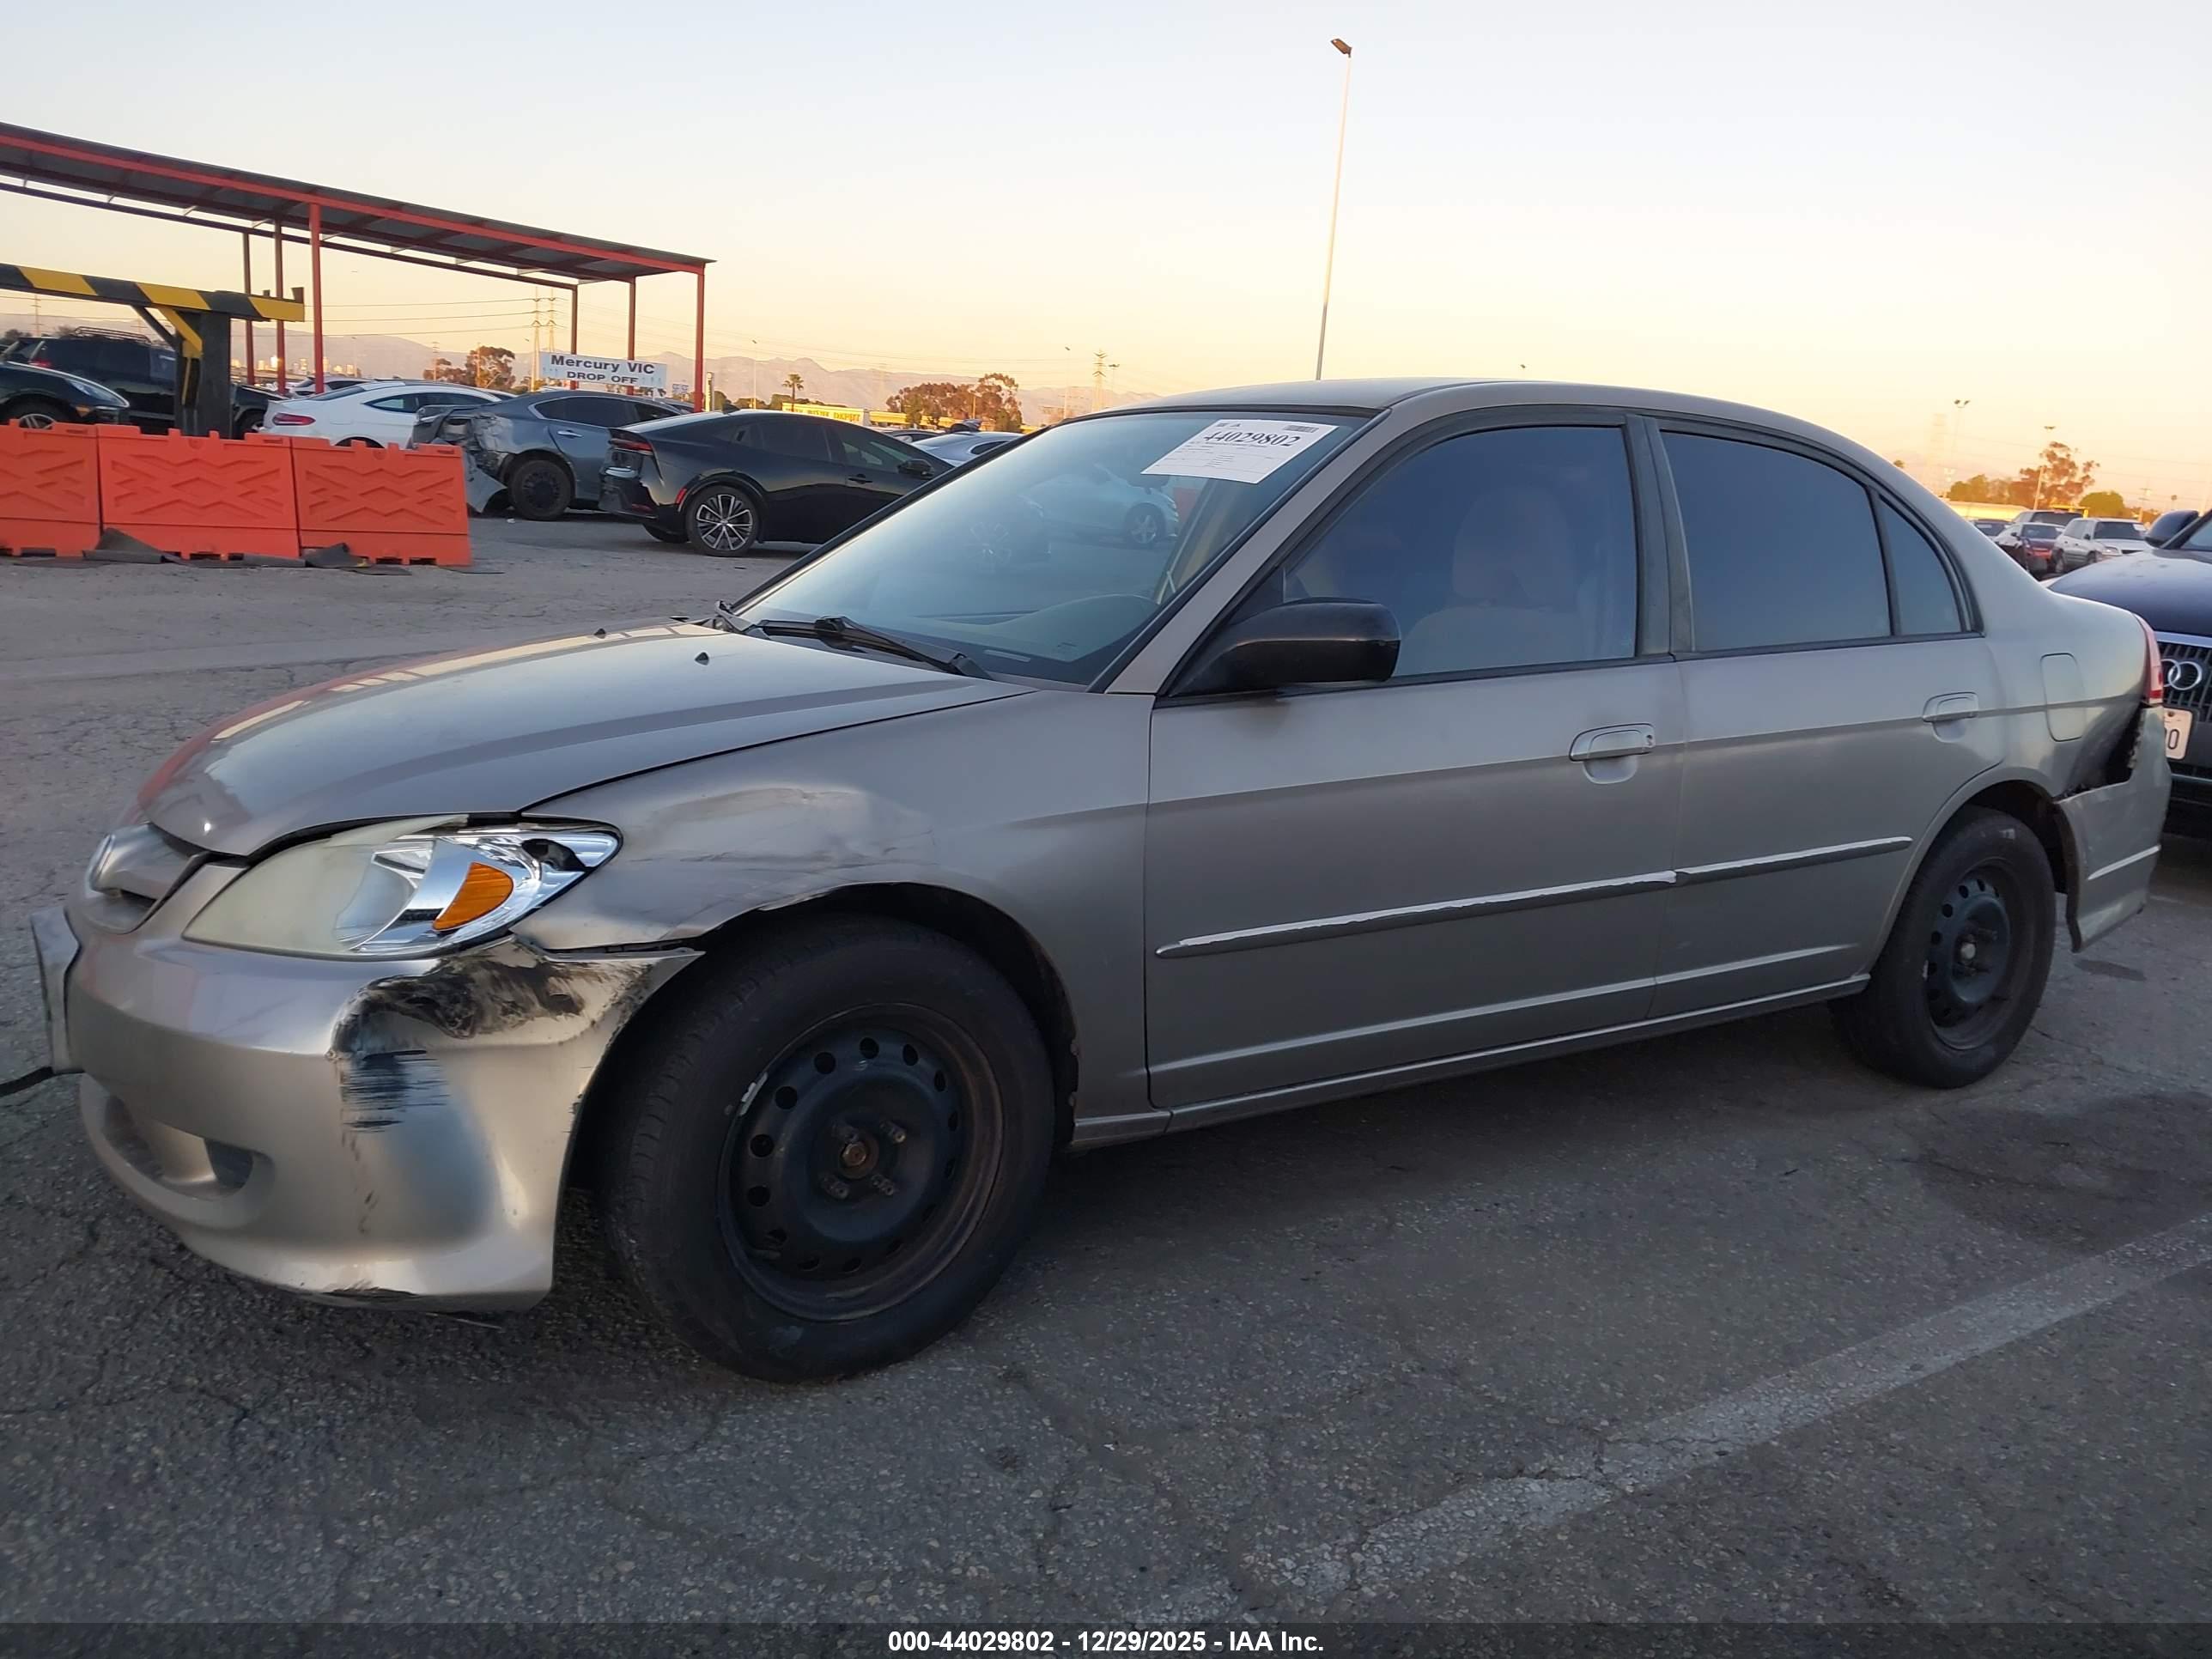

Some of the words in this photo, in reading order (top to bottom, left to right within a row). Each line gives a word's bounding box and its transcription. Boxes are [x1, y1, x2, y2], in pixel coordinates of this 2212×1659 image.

[550, 355, 620, 373] Mercury
[627, 362, 655, 374] VIC
[567, 371, 605, 380] DROP
[611, 375, 639, 384] OFF
[1203, 431, 1301, 447] 44029802
